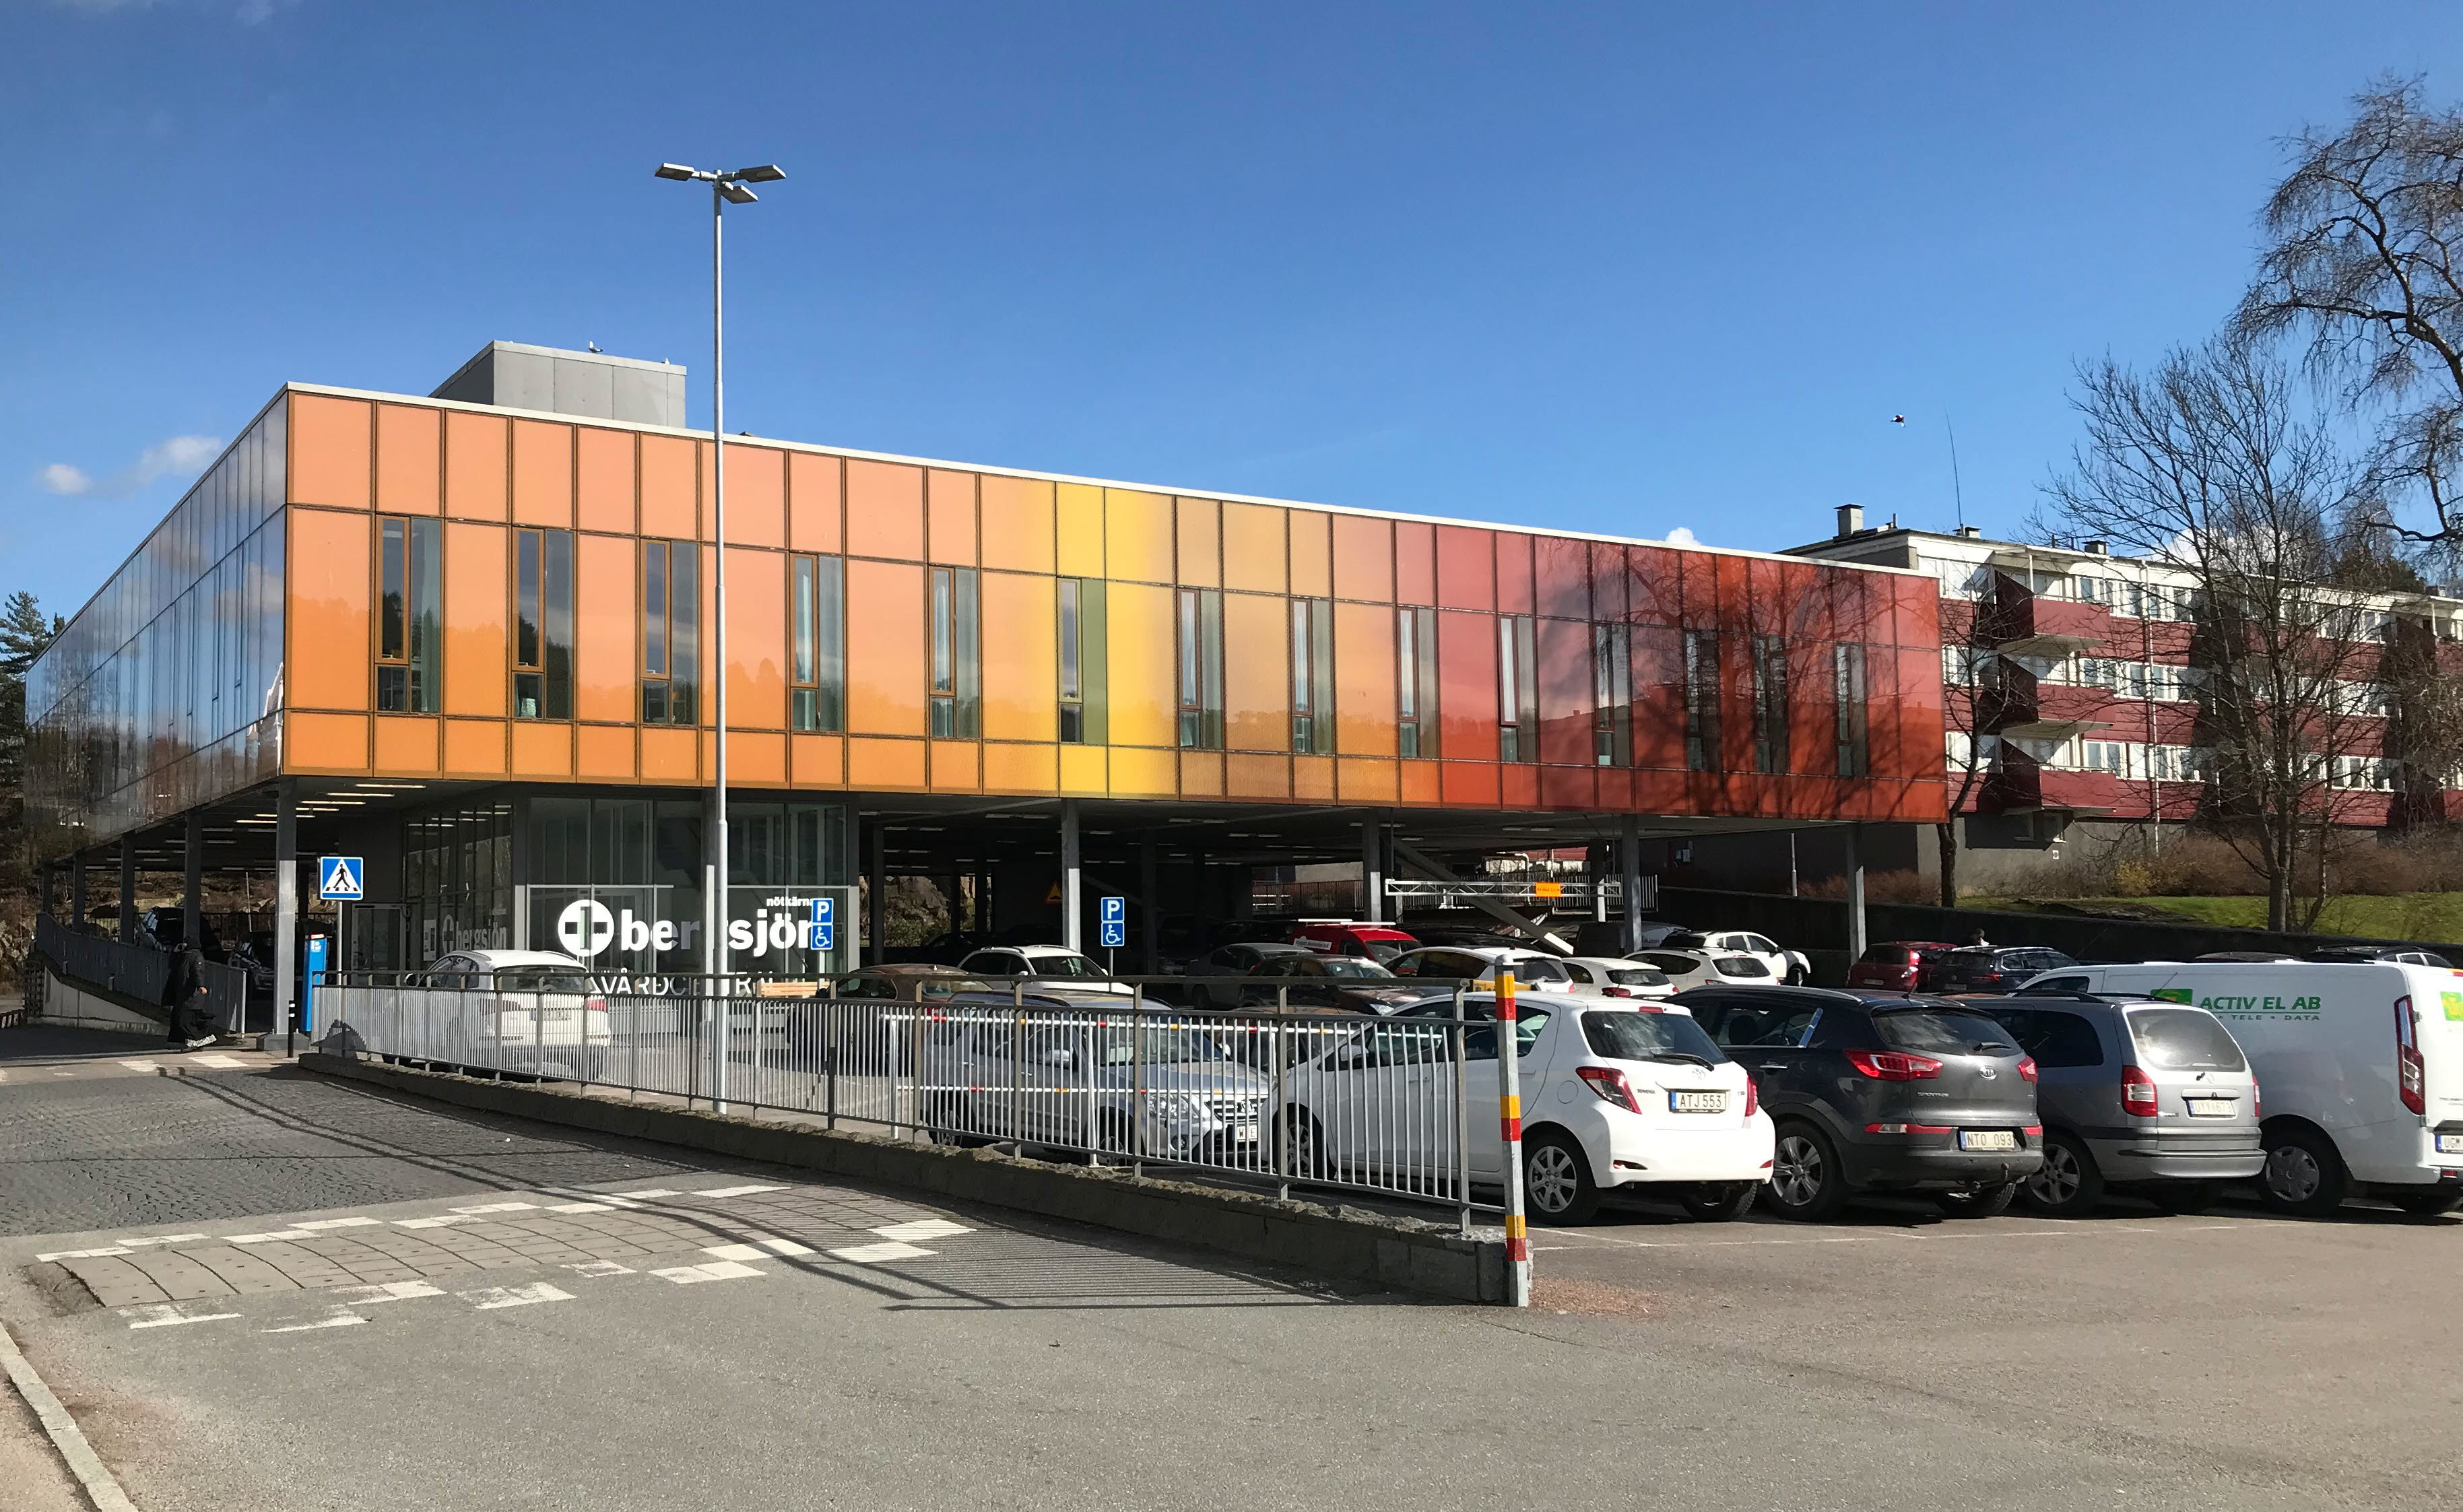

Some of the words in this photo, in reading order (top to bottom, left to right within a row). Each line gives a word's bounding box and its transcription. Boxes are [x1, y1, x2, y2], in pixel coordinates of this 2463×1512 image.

[817, 901, 829, 921] P
[1107, 900, 1120, 919] P
[621, 909, 812, 956] bersjö
[2200, 997, 2256, 1010] ACTIV
[2262, 997, 2286, 1010] EL
[2291, 997, 2321, 1010] AB
[1680, 1094, 1699, 1107] ATJ
[1703, 1094, 1721, 1107] 553
[2216, 1101, 2232, 1113] 673
[1967, 1133, 1986, 1146] NTO
[1994, 1134, 2012, 1146] 093
